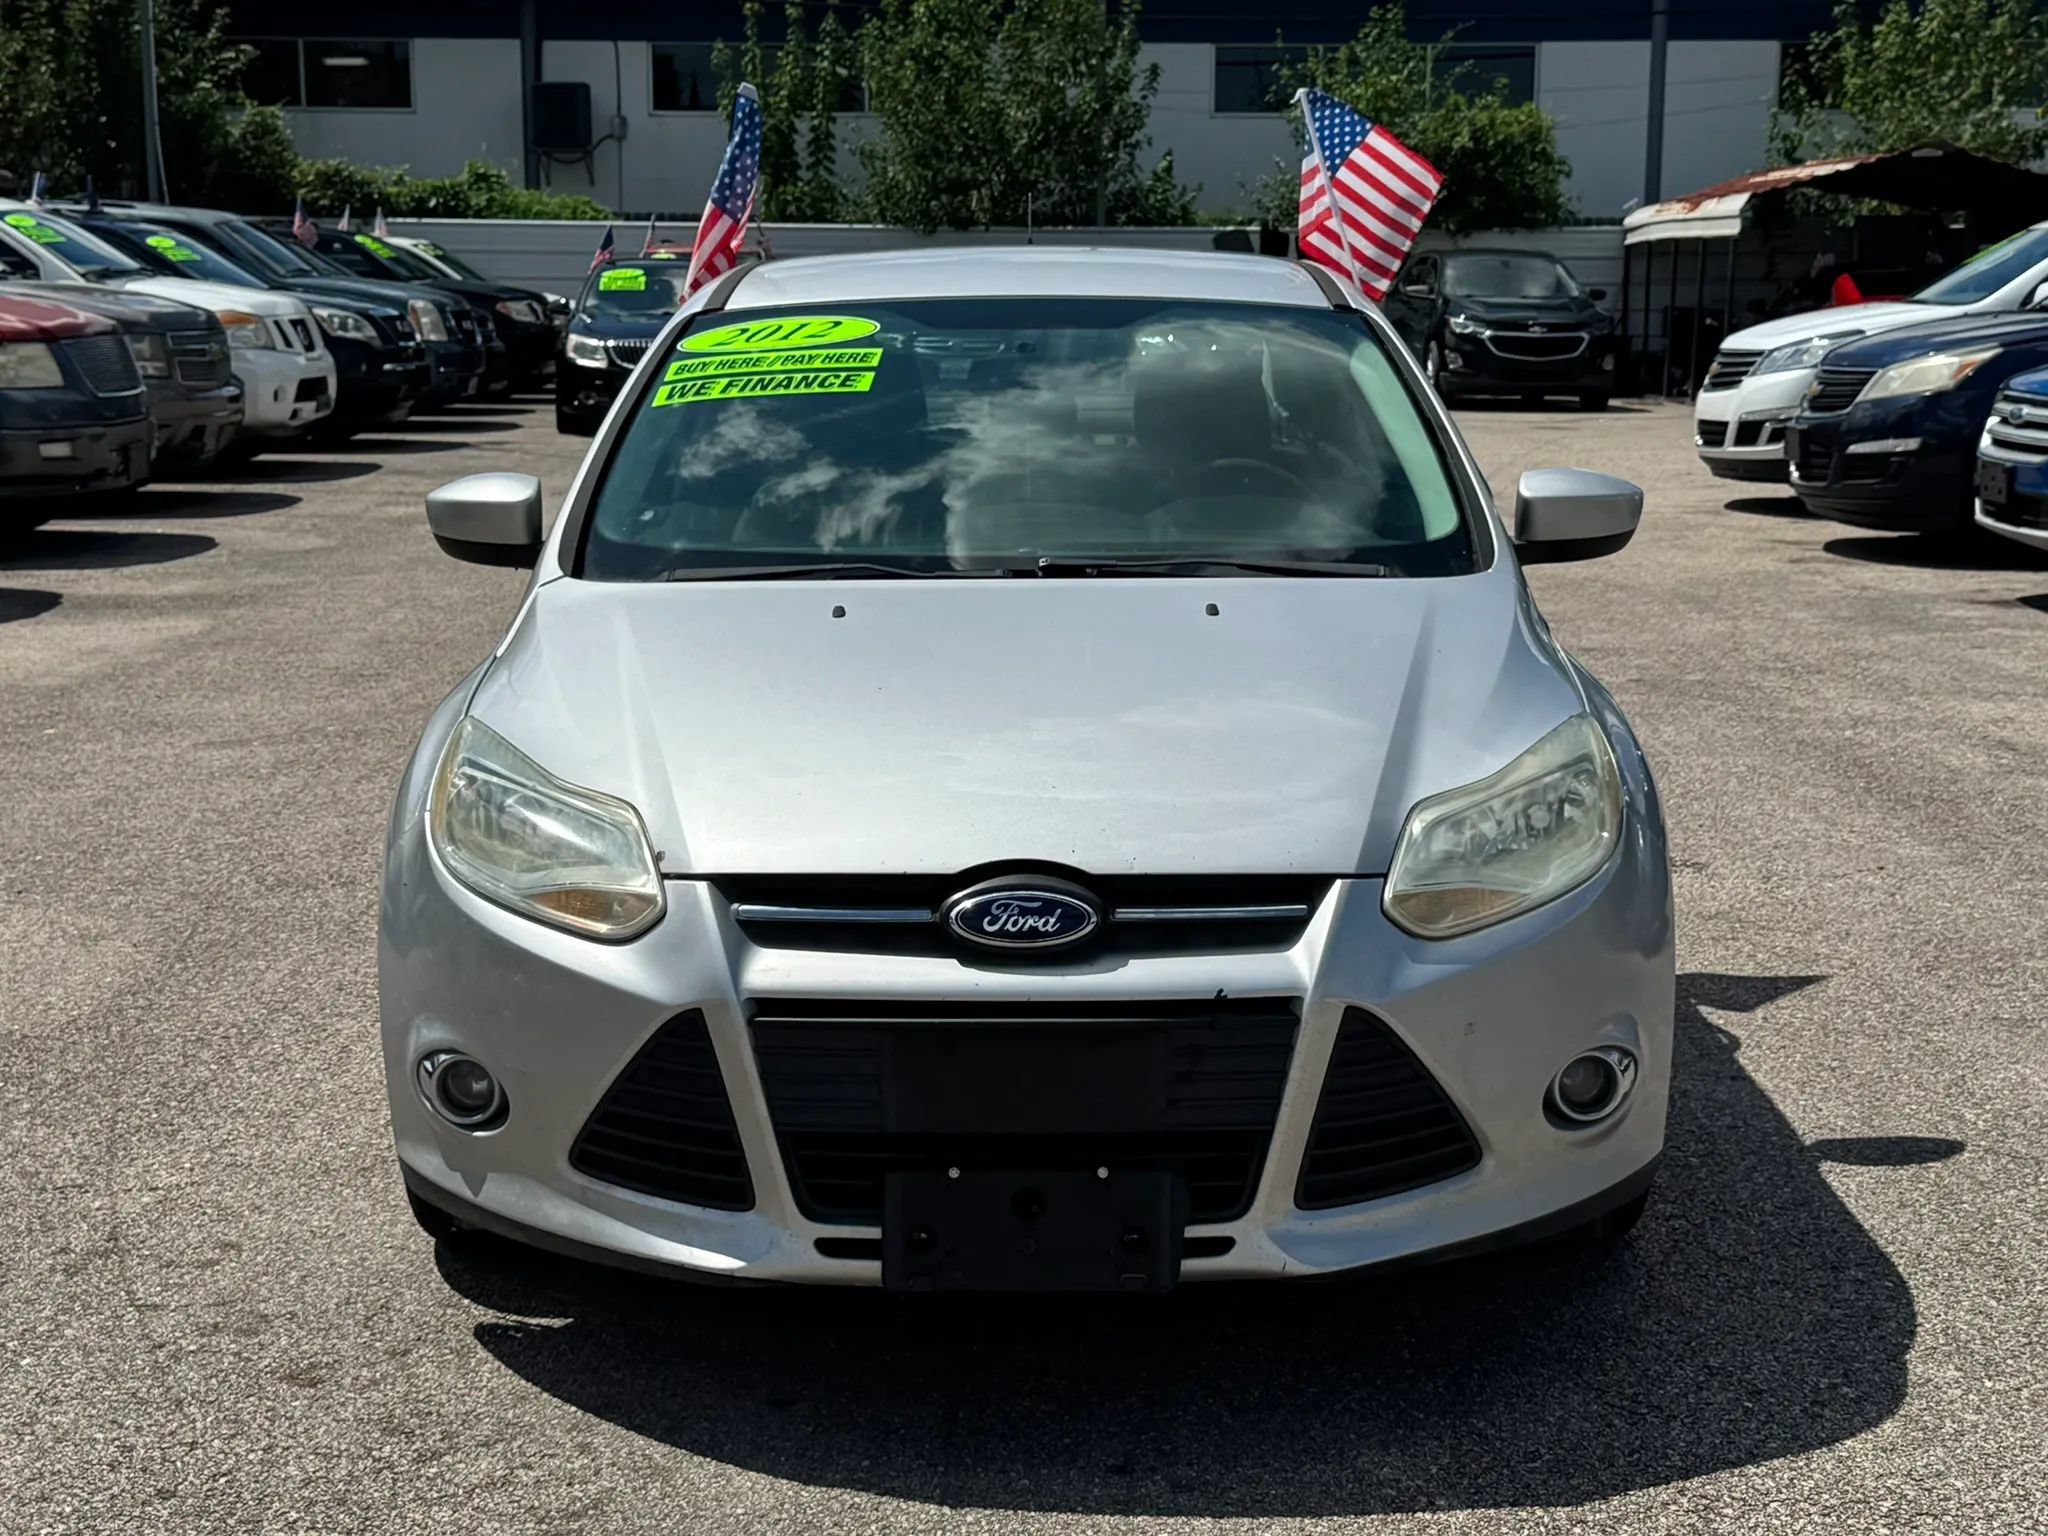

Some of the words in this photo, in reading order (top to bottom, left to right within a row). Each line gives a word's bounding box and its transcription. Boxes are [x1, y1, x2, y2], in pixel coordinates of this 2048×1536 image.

[708, 320, 844, 348] 2012
[672, 359, 717, 377] BUY
[714, 356, 770, 371] HERE
[780, 353, 823, 368] PAY
[820, 351, 877, 365] HERE
[664, 380, 720, 401] WE
[719, 373, 866, 396] FINANCE
[982, 899, 1063, 933] Ford
